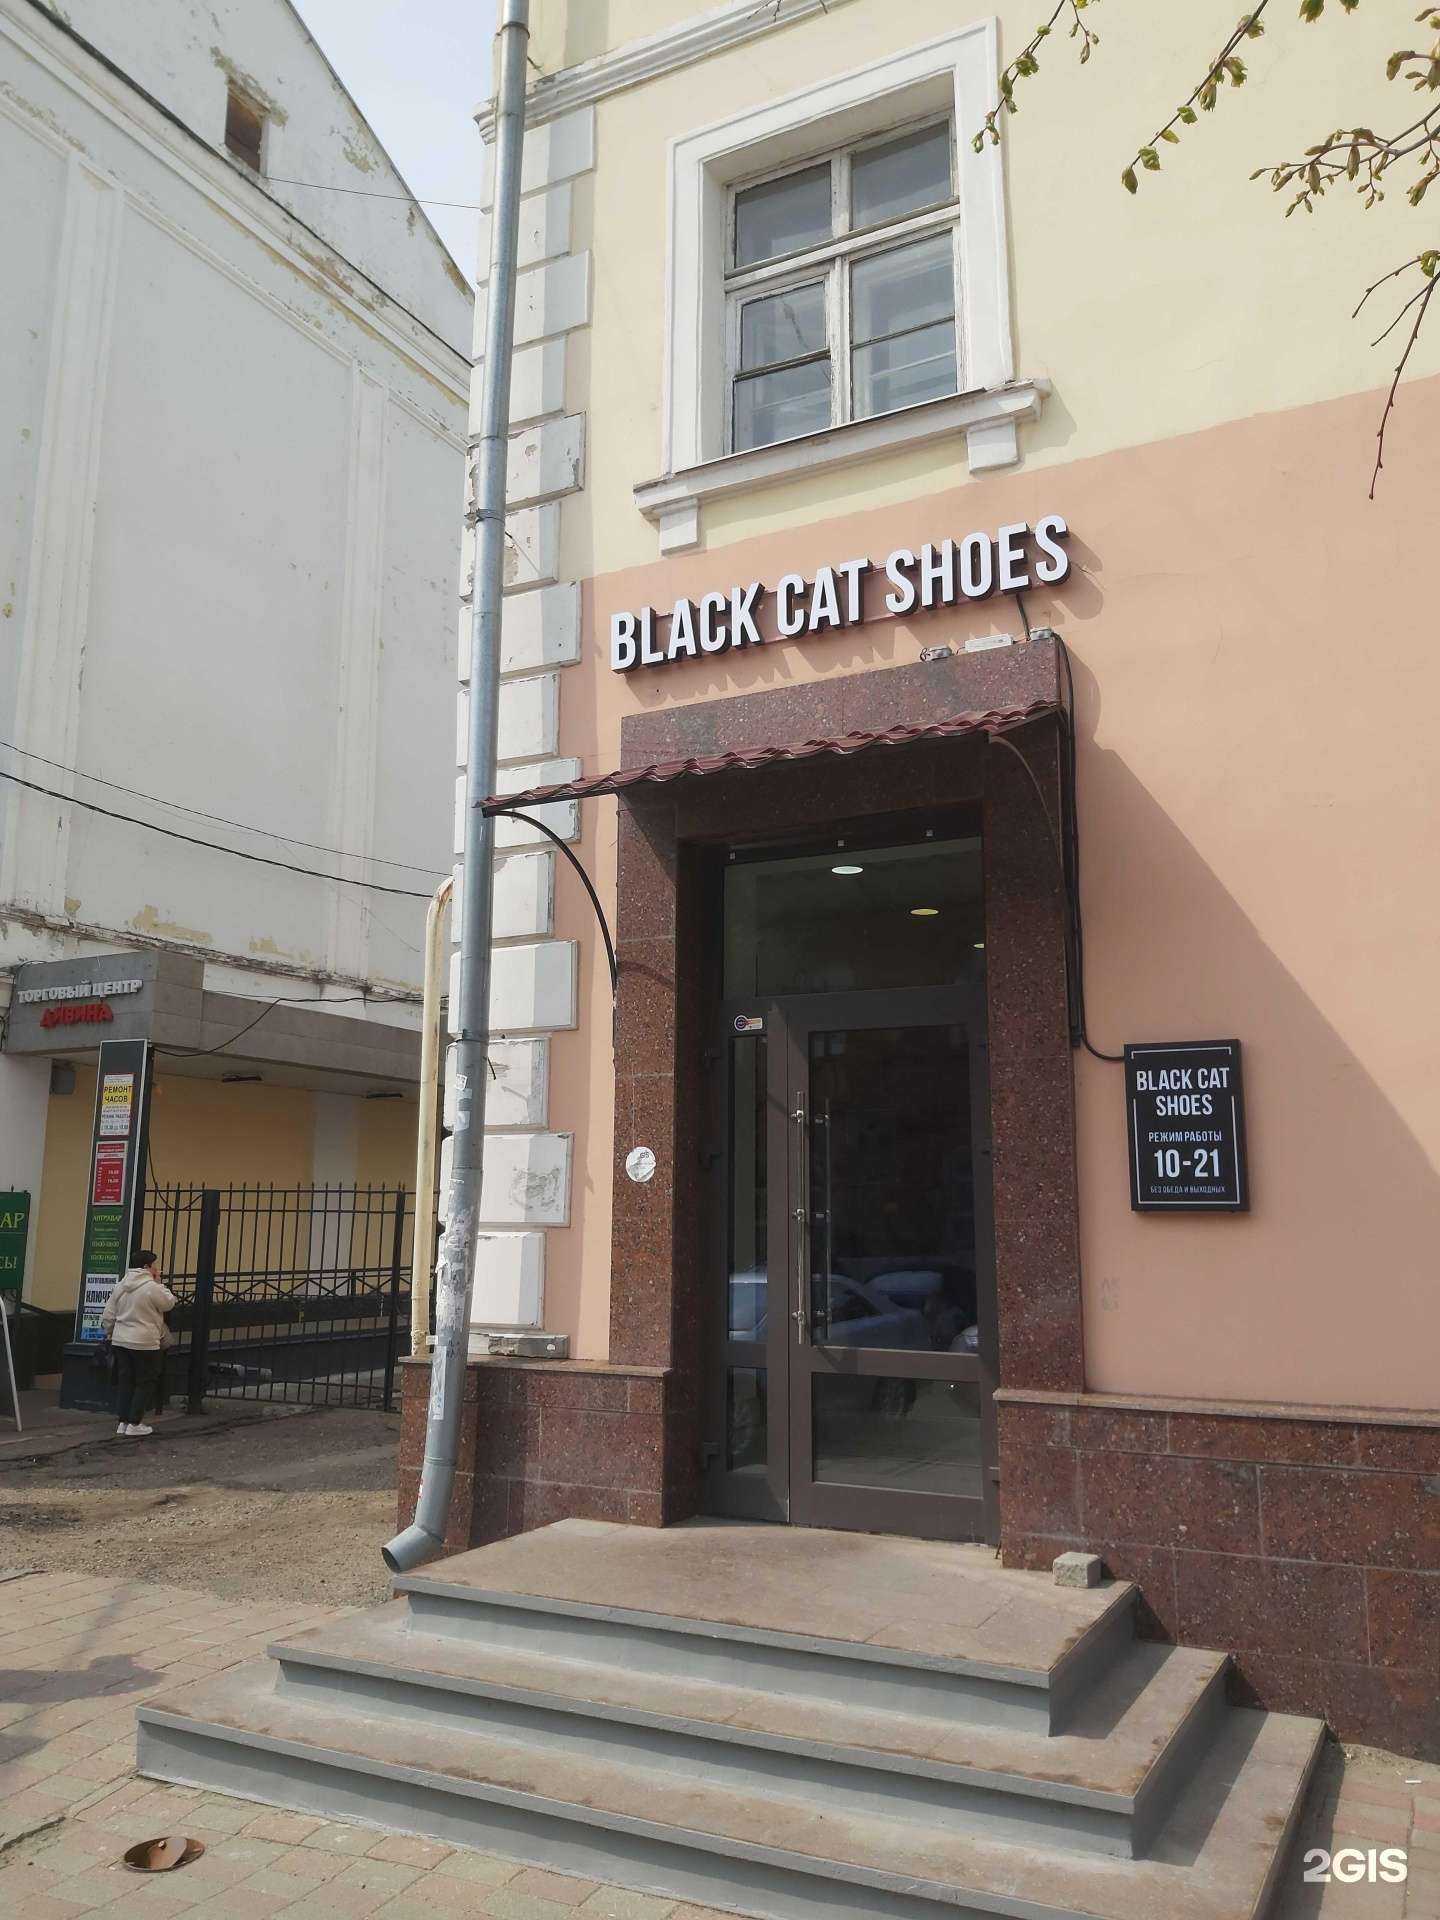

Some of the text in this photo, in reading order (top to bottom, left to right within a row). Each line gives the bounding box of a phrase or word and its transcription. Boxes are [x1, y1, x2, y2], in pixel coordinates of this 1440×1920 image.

[609, 515, 1069, 673] BLACK CAT SHOES
[17, 979, 143, 1003] ТОРГОВЫЙ ЦЕНТР
[1136, 1067, 1230, 1091] BLACK CAT
[104, 1084, 133, 1094] РЕМОНТ
[105, 1095, 128, 1103] ЧАСОВ
[1156, 1094, 1213, 1117] SHOES
[1148, 1130, 1222, 1143] РЕЖИМ РАБОТЫ
[1150, 1184, 1226, 1193] БЕЗ ОБЕДА И ВЫХОДНЫХ
[86, 1290, 112, 1303] КЛЮЧЕ
